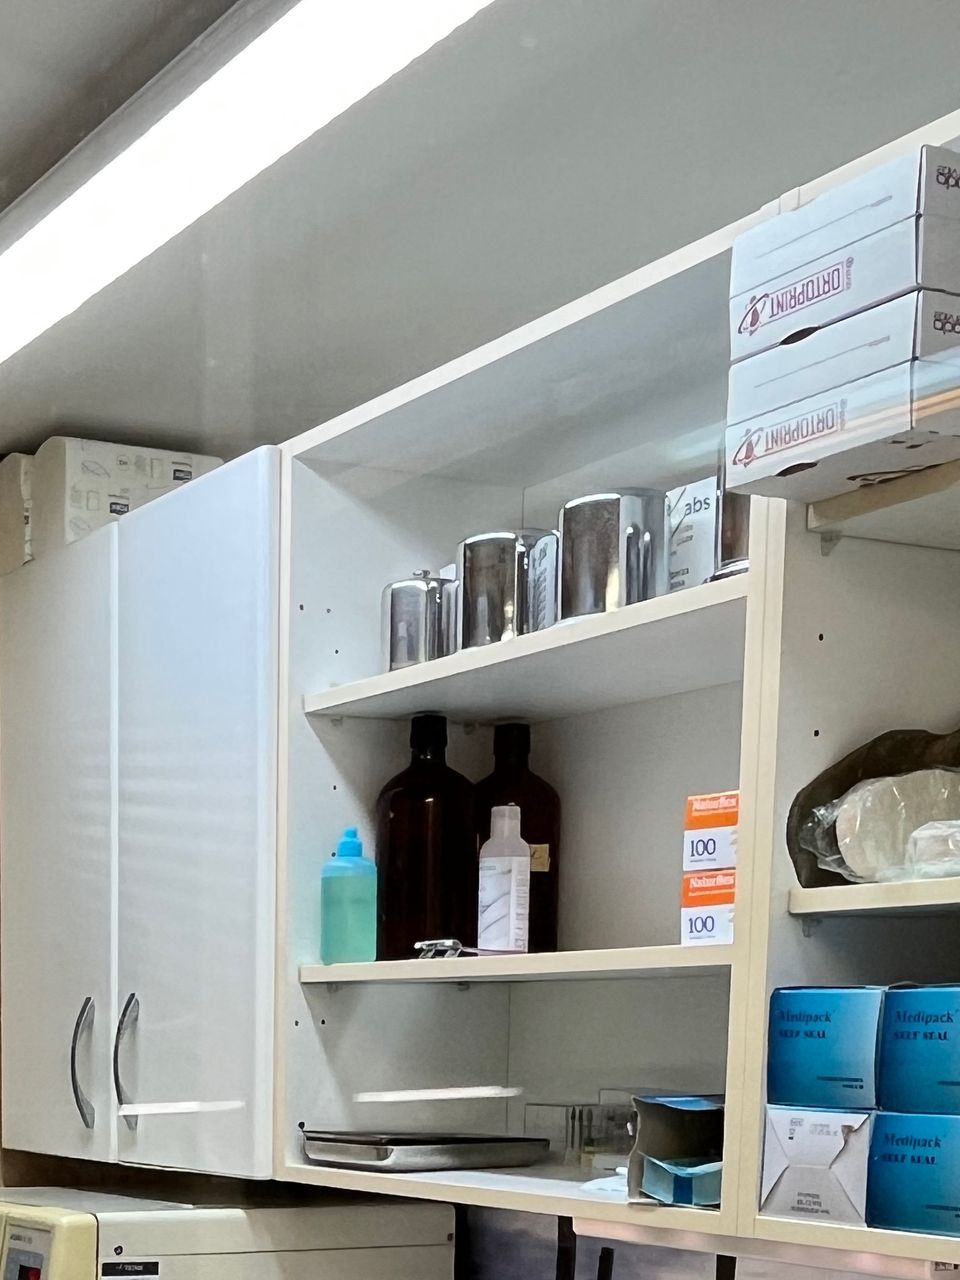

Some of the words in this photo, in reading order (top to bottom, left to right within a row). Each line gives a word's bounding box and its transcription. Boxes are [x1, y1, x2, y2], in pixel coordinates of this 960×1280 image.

[768, 267, 841, 319] ORTOPRINT
[765, 405, 836, 452] ORTOPRINT
[690, 838, 716, 858] 100
[688, 915, 715, 934] 100
[896, 1010, 954, 1026] Medipack
[884, 1132, 942, 1150] Medipack
